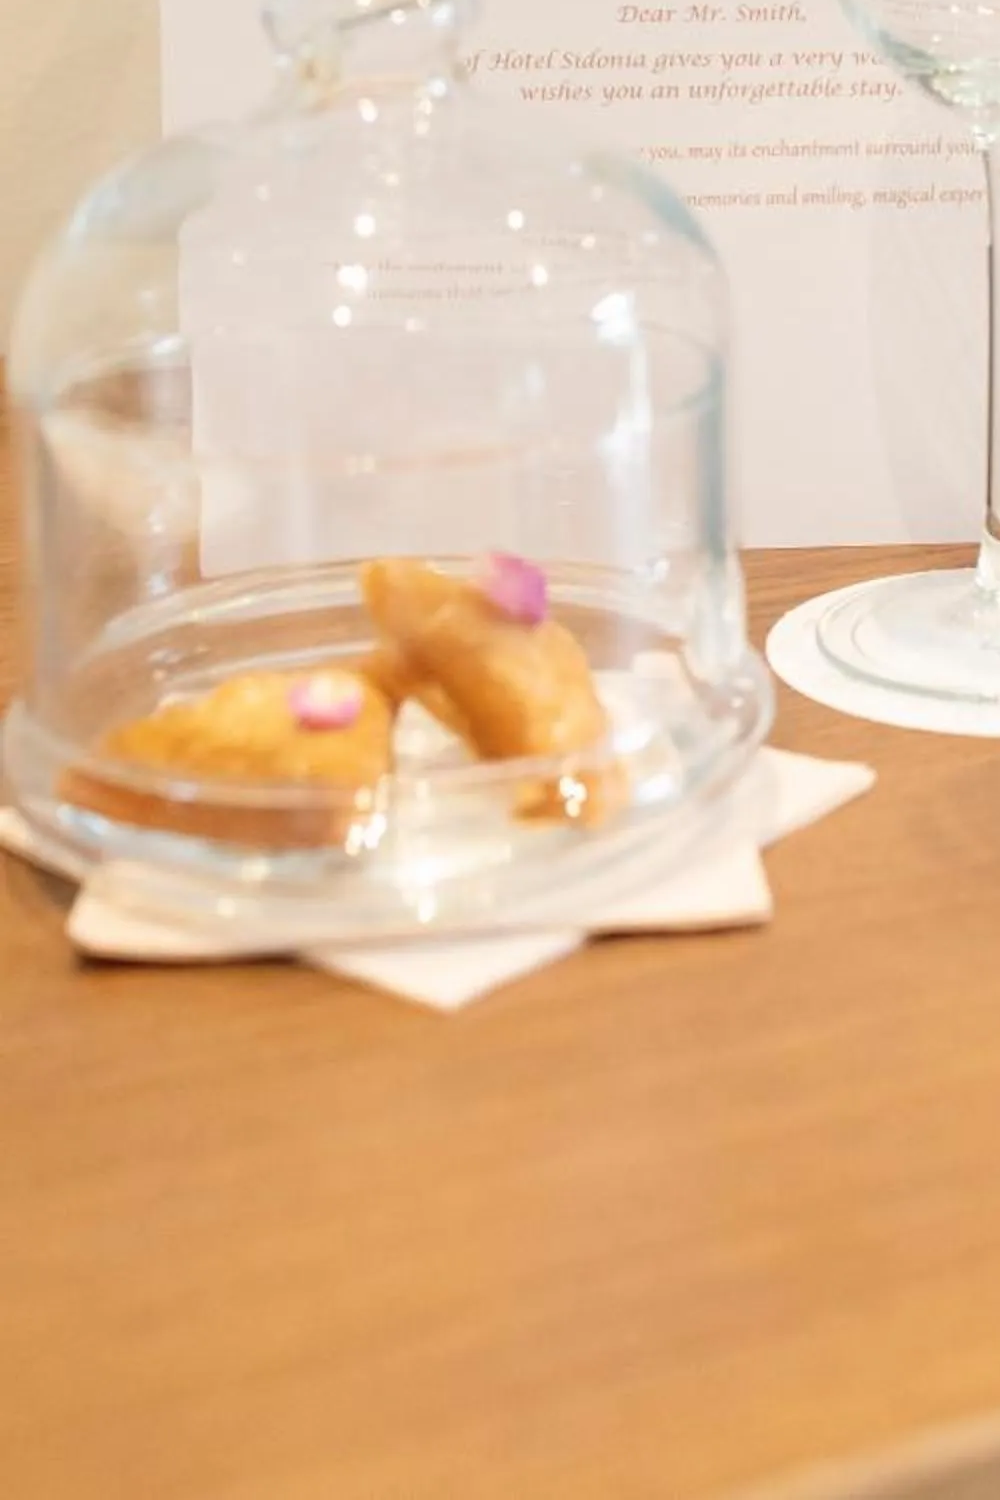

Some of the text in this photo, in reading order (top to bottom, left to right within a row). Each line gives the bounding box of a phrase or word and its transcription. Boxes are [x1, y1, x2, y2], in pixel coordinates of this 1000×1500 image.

[616, 4, 677, 23] Dear
[683, 4, 727, 23] Mr.
[486, 49, 556, 72] Hotel
[559, 47, 646, 70] Sidonia
[651, 49, 712, 73] gives
[720, 52, 763, 72] you
[769, 53, 784, 67] a
[793, 52, 844, 72] very
[519, 78, 904, 107] wishes you an unforgettable stay.
[688, 146, 723, 163] may
[726, 138, 747, 158] its
[750, 136, 860, 158] enchantment
[864, 134, 943, 156] surround
[765, 185, 797, 206] and
[872, 181, 935, 209] magical
